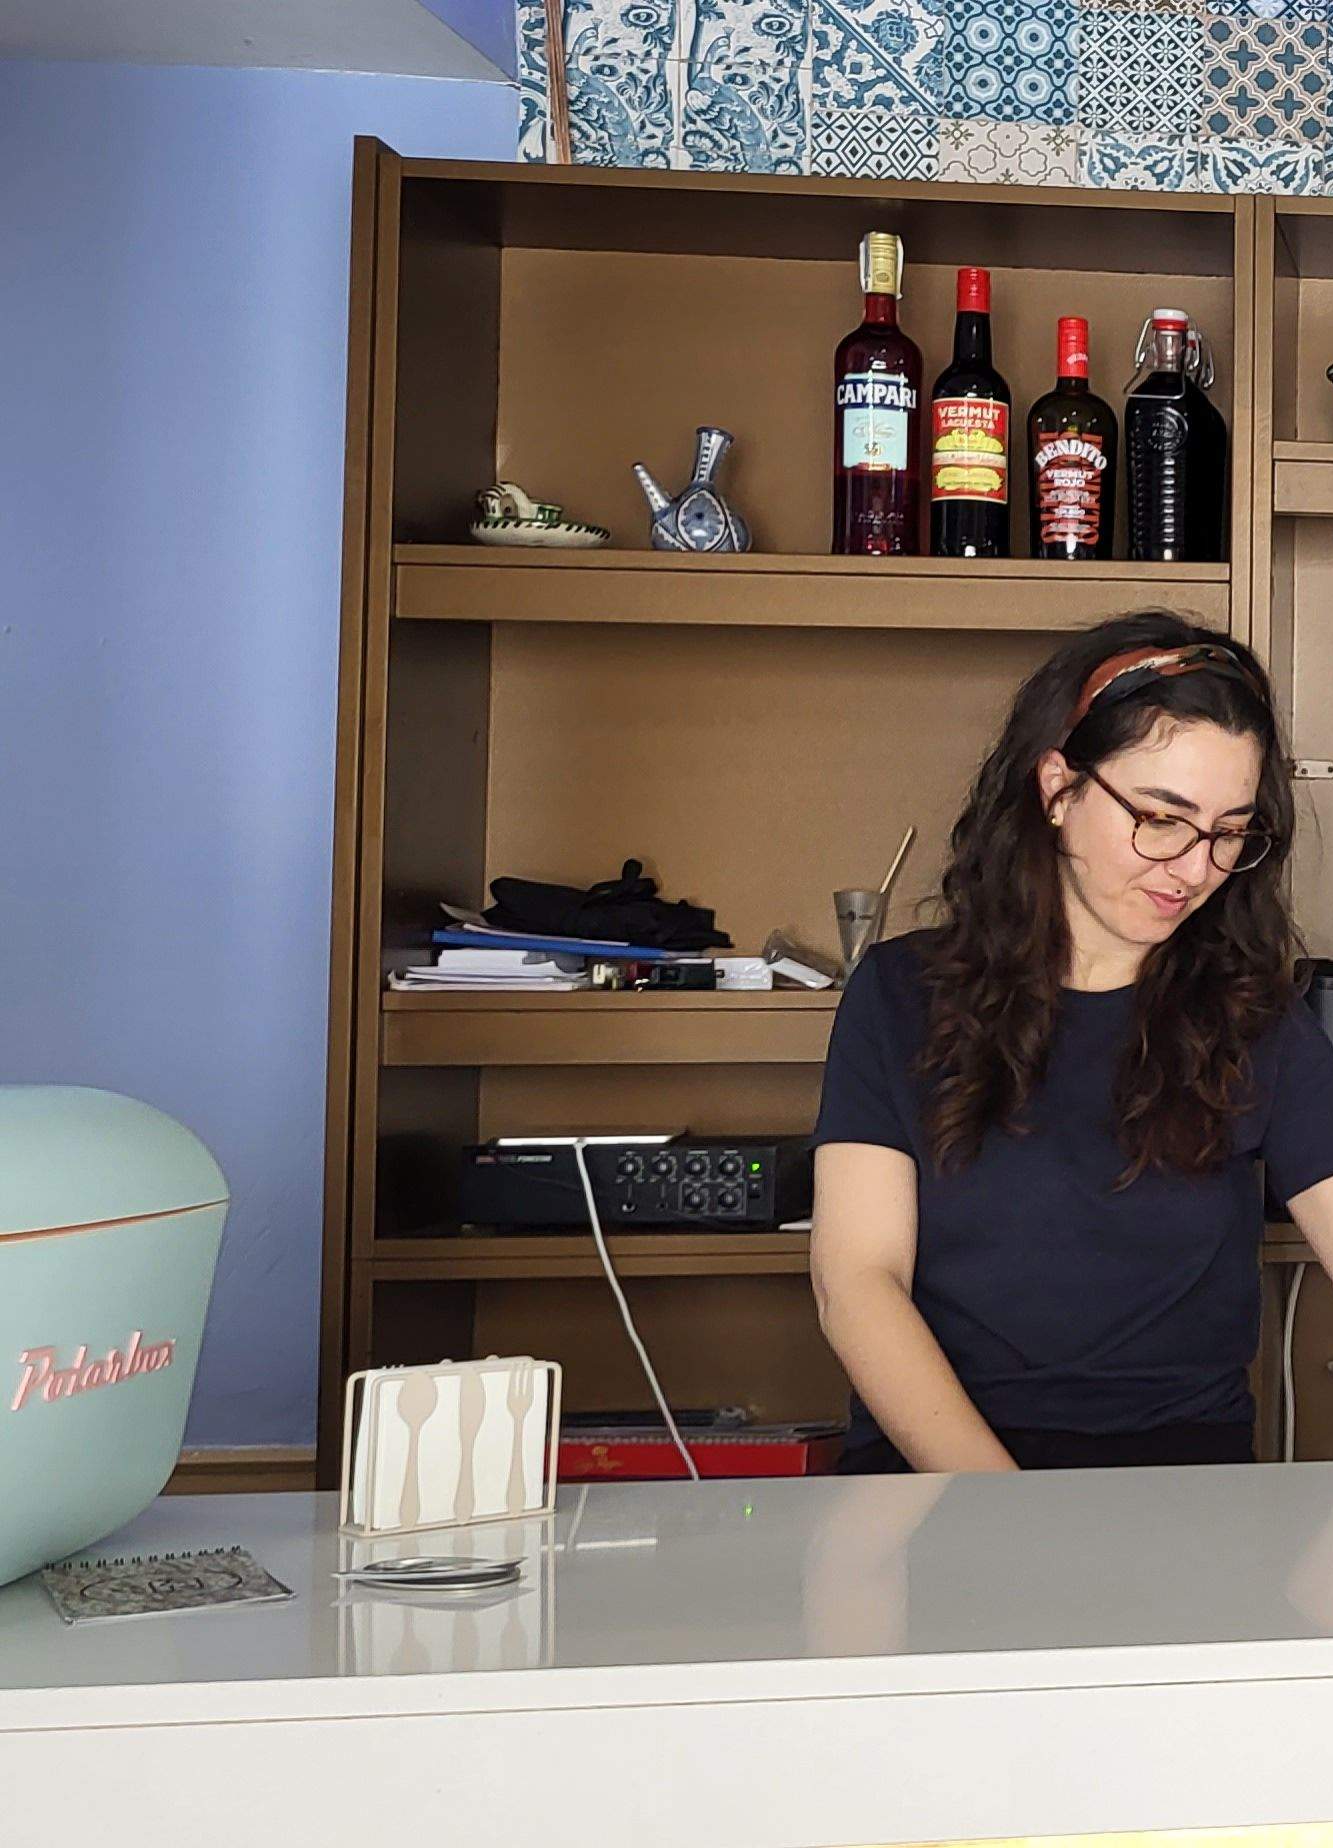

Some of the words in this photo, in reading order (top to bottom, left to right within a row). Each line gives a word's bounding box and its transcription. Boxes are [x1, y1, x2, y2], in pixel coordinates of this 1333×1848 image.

[837, 383, 917, 409] CAMPARI
[938, 405, 1000, 421] VERMUT
[1035, 439, 1107, 471] BENDITO
